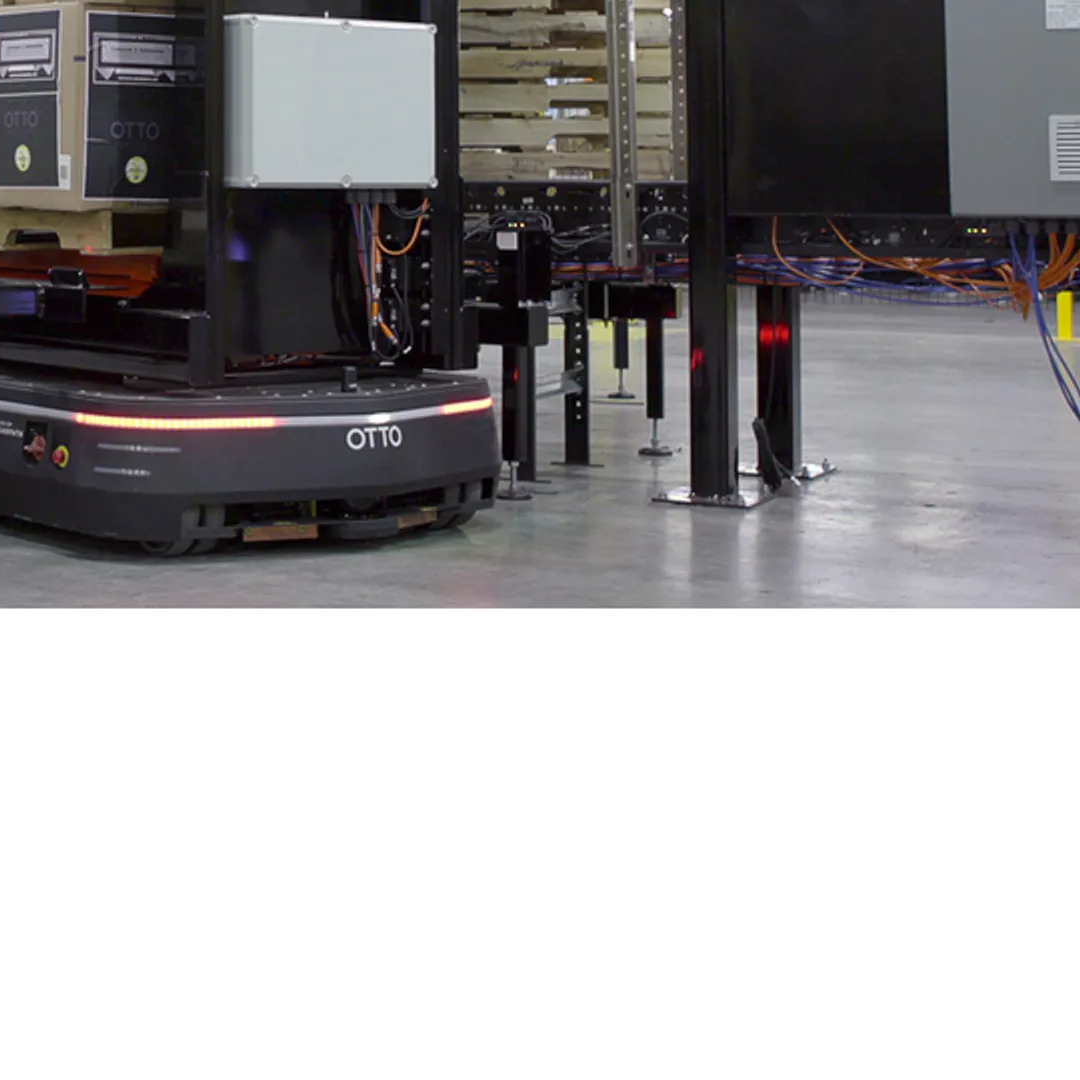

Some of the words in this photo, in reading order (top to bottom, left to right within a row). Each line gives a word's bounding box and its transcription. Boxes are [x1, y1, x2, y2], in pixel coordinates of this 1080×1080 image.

[4, 110, 39, 128] OTTO
[110, 120, 160, 140] OTTO
[346, 424, 403, 451] OTTO
